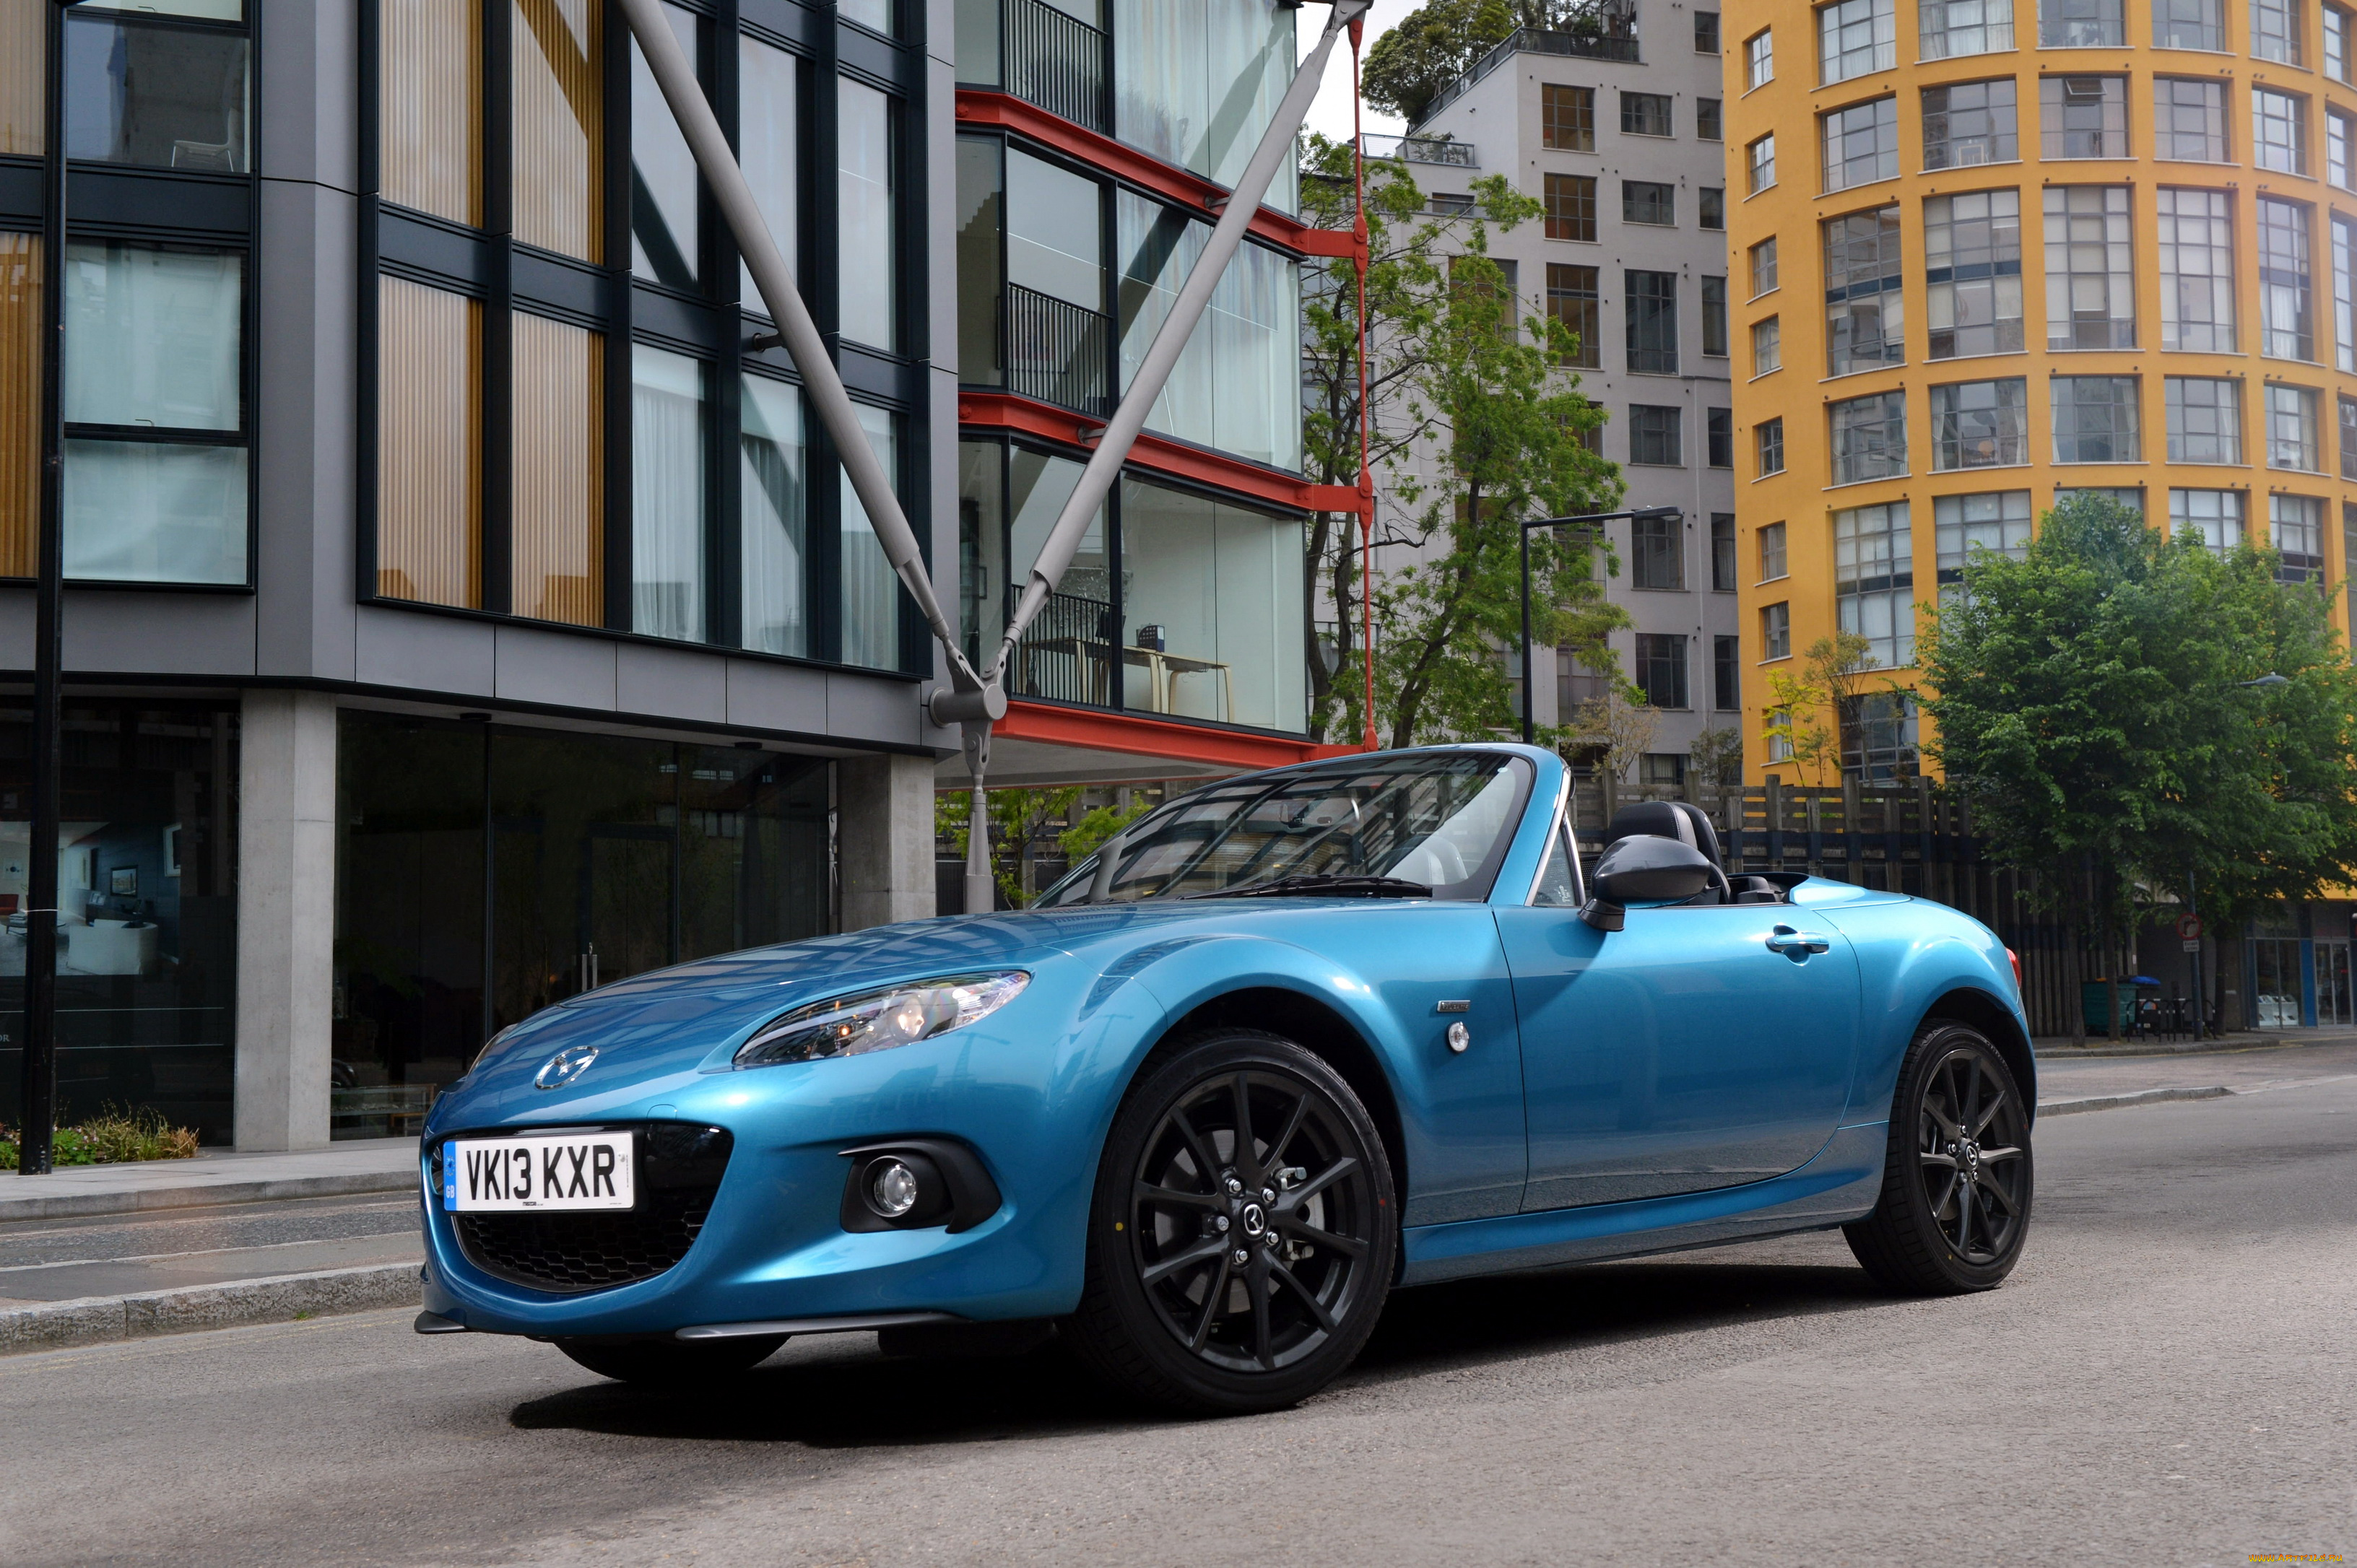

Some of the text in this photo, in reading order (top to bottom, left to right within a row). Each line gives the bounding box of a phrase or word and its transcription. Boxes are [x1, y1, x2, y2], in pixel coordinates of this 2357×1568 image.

[466, 1148, 531, 1200] VK13
[543, 1144, 616, 1199] KXR
[446, 1185, 455, 1198] GB
